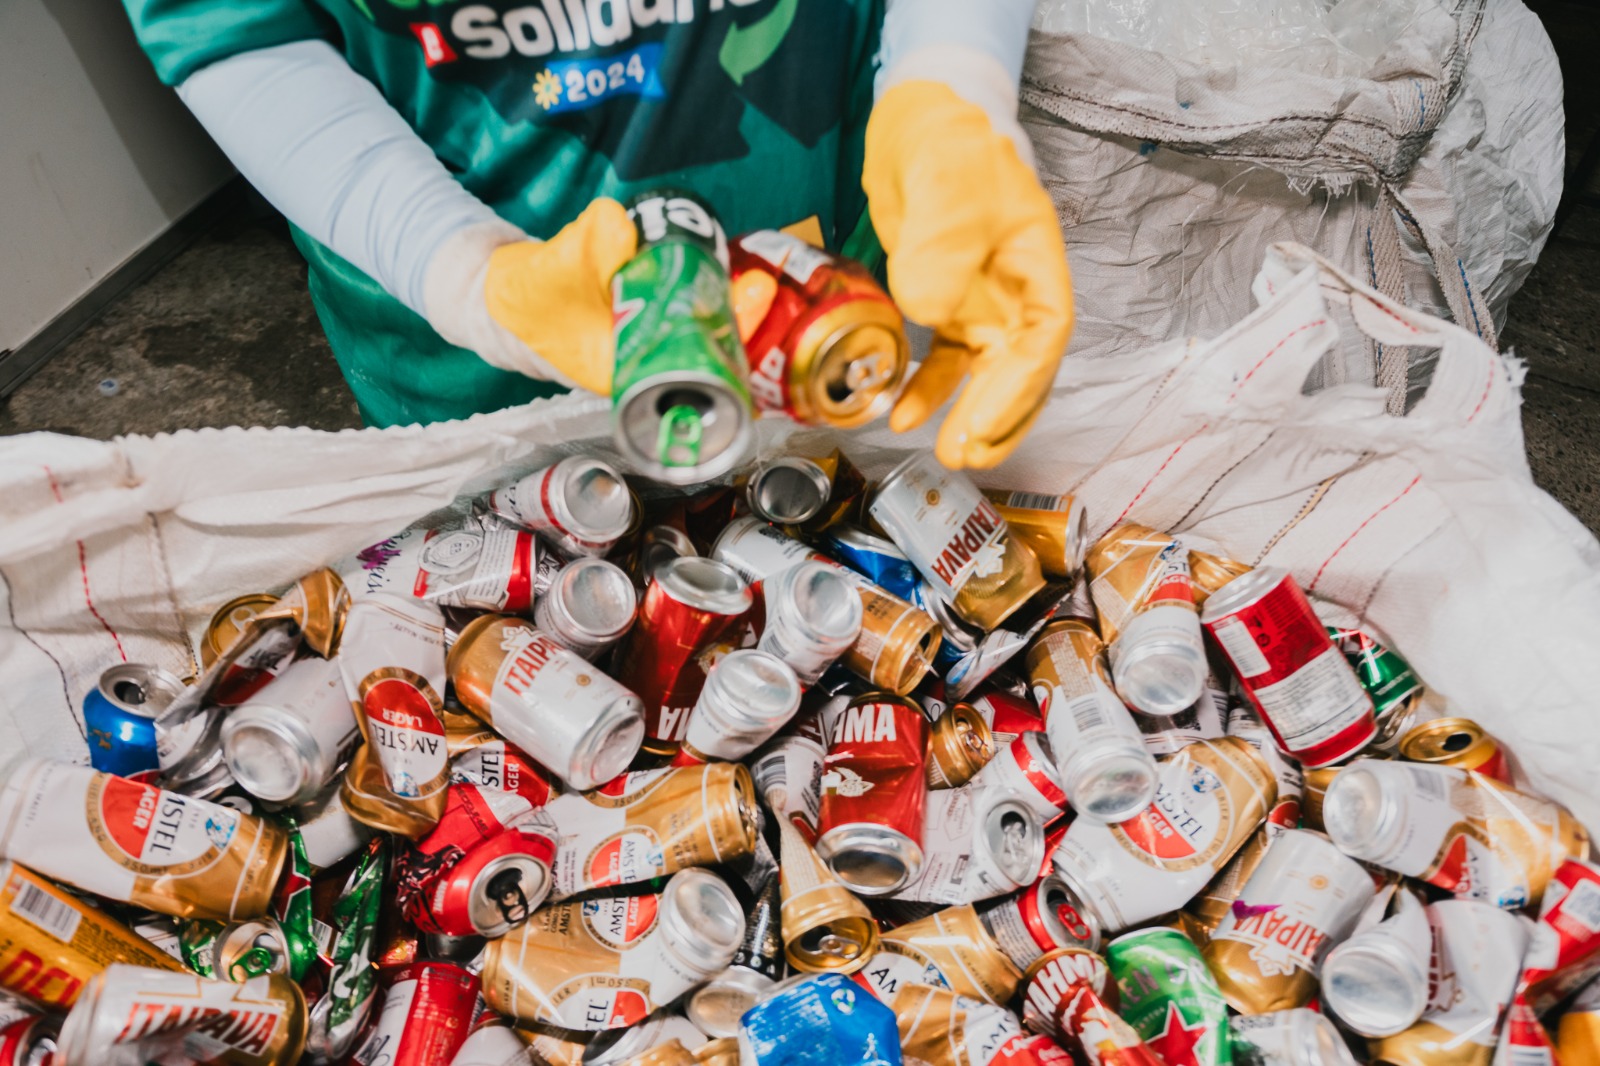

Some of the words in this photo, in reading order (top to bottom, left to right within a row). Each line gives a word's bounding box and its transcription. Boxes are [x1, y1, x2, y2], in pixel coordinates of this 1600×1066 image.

[566, 54, 646, 102] 2024
[929, 499, 1001, 586] TAIPAVA
[502, 632, 562, 695] ITAIPA
[370, 723, 439, 756] AMSTEL
[382, 707, 423, 728] LAGER
[132, 786, 158, 830] AGER
[149, 794, 186, 852] STEL
[1145, 805, 1175, 839] AGER
[1155, 783, 1207, 842] MSTEL
[622, 840, 638, 883] AMSTE
[609, 897, 625, 935] AMST
[1232, 906, 1332, 958] AIPAV
[552, 989, 572, 1003] IER
[113, 1002, 281, 1055] ITAIPAVA
